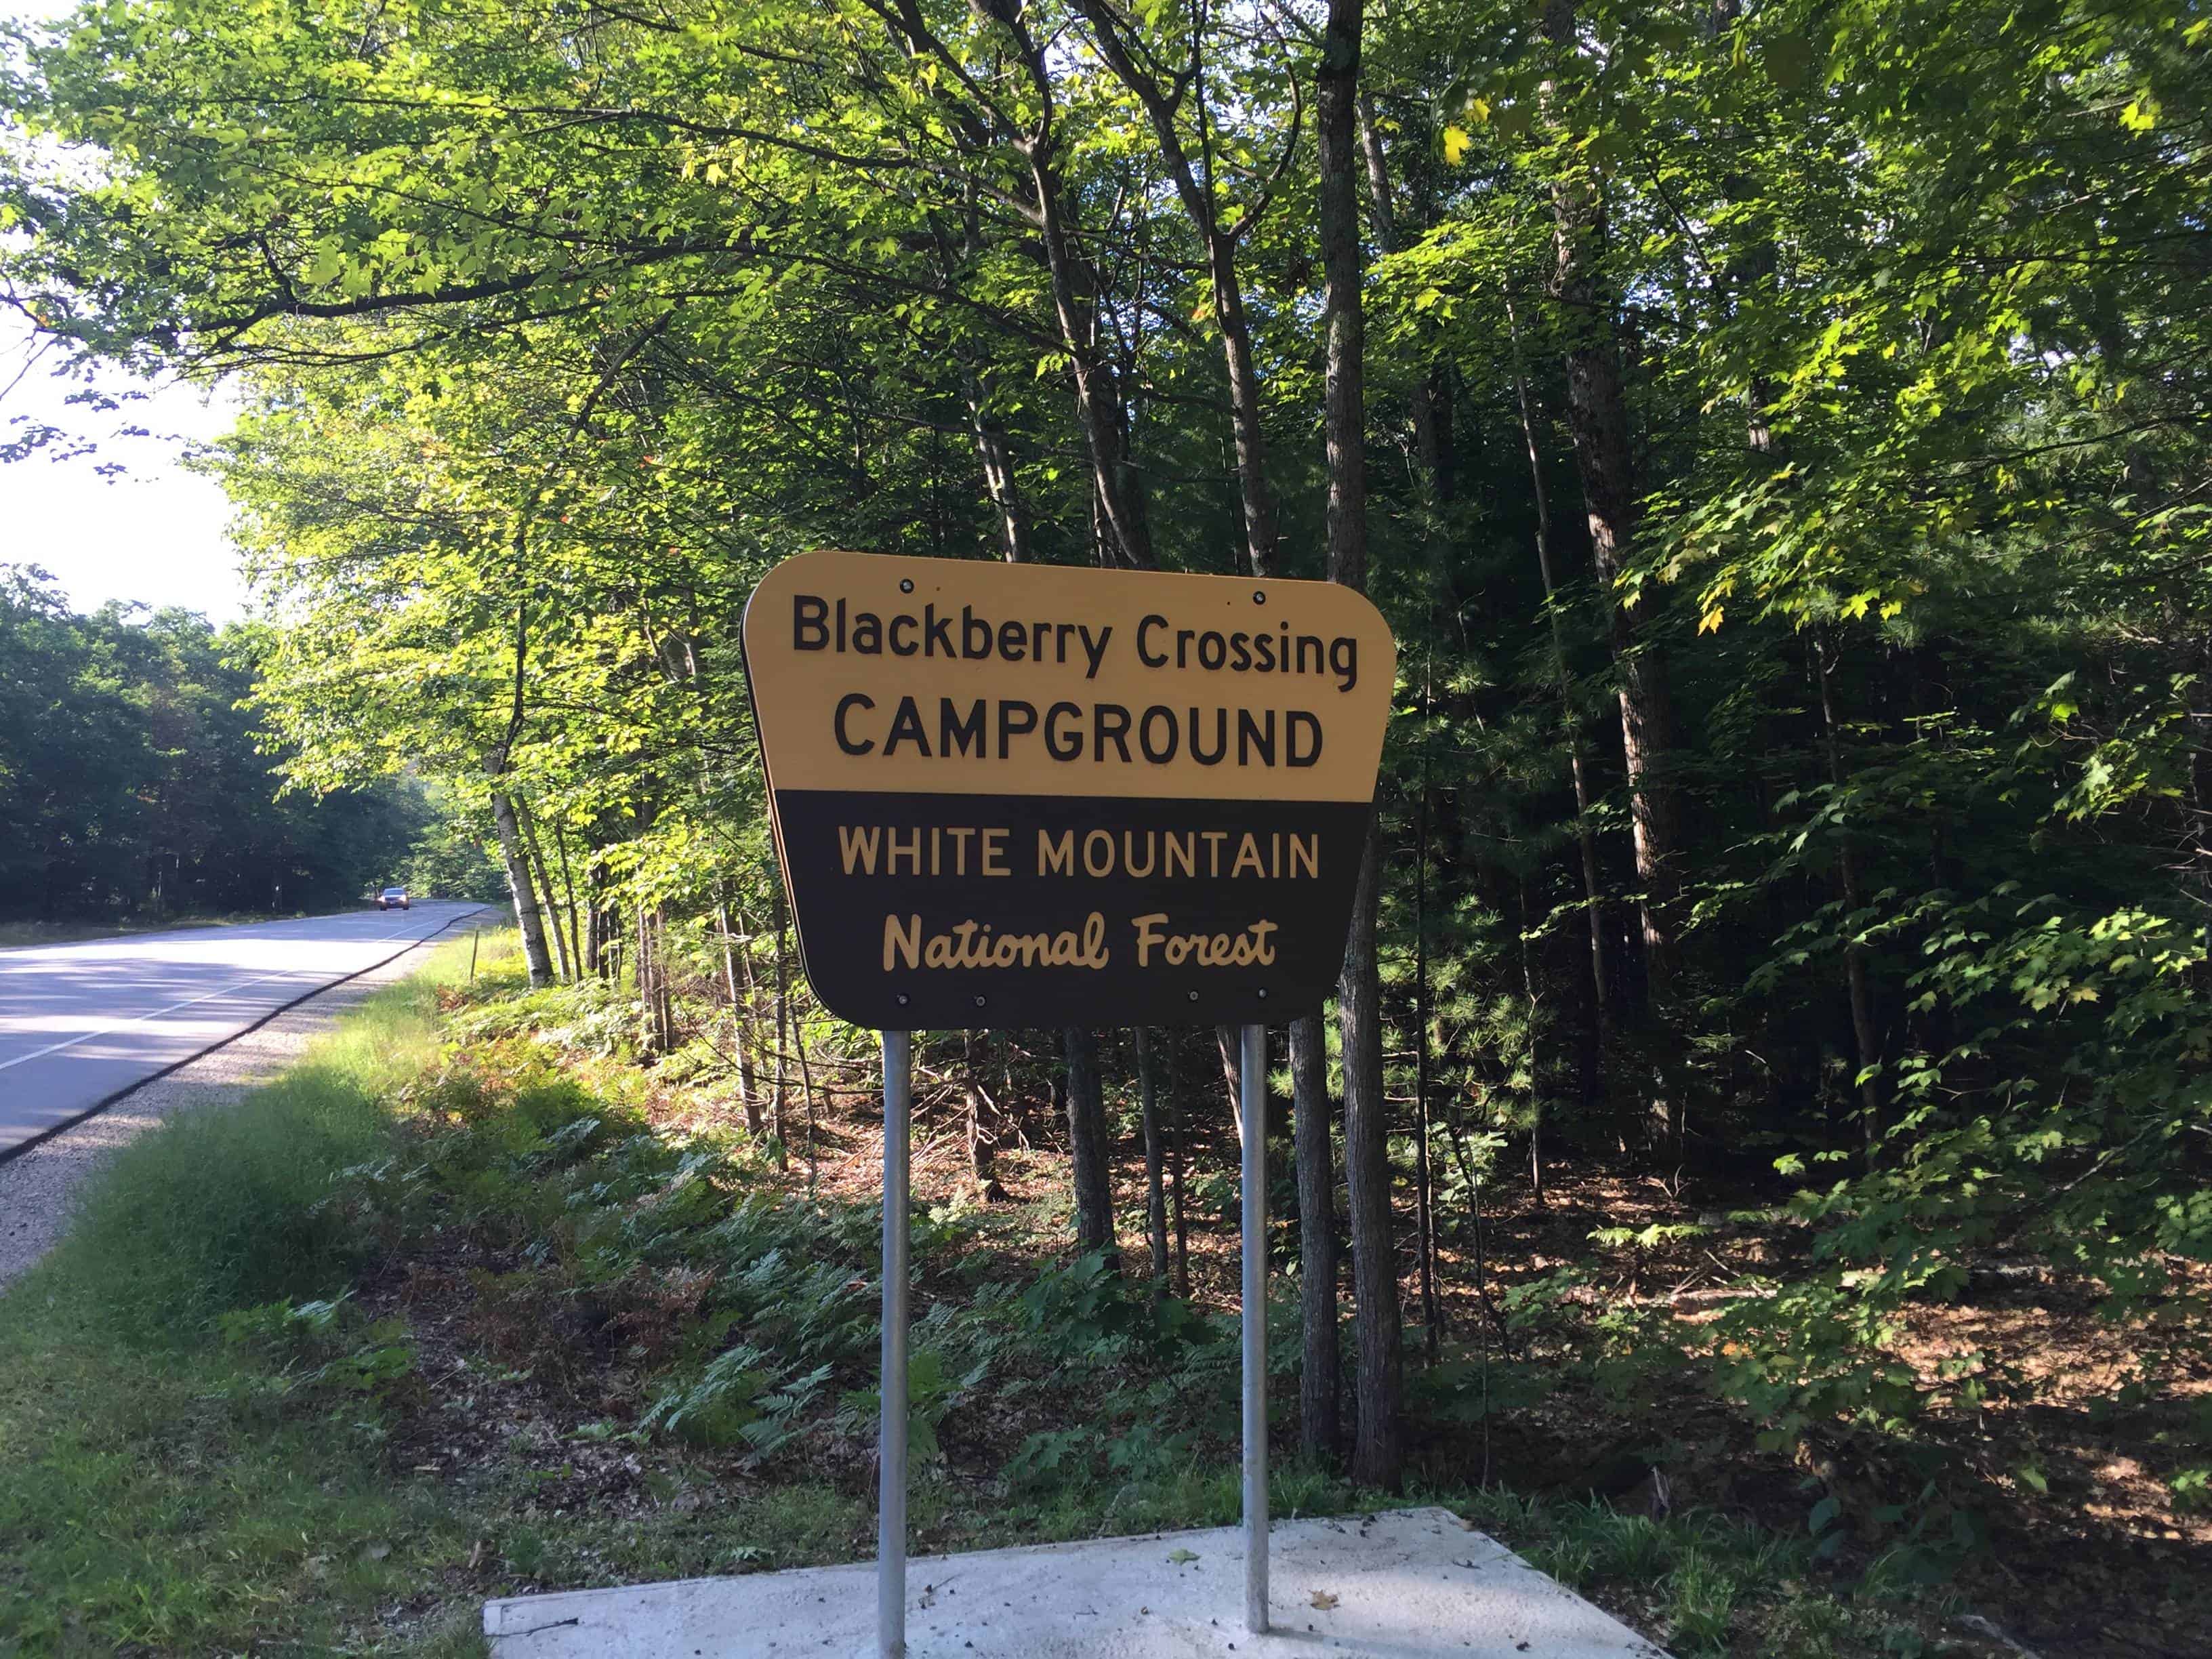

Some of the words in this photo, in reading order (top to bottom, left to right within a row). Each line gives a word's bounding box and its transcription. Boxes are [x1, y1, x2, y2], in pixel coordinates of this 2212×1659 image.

[794, 595, 1113, 678] Blackberry
[1137, 615, 1357, 693] Crossing
[835, 693, 1322, 767] CAMPGROUND
[839, 826, 1010, 876] WHITE
[1039, 830, 1317, 878] MOUNTAIN
[884, 912, 1109, 971] National
[1132, 914, 1277, 966] Forest
